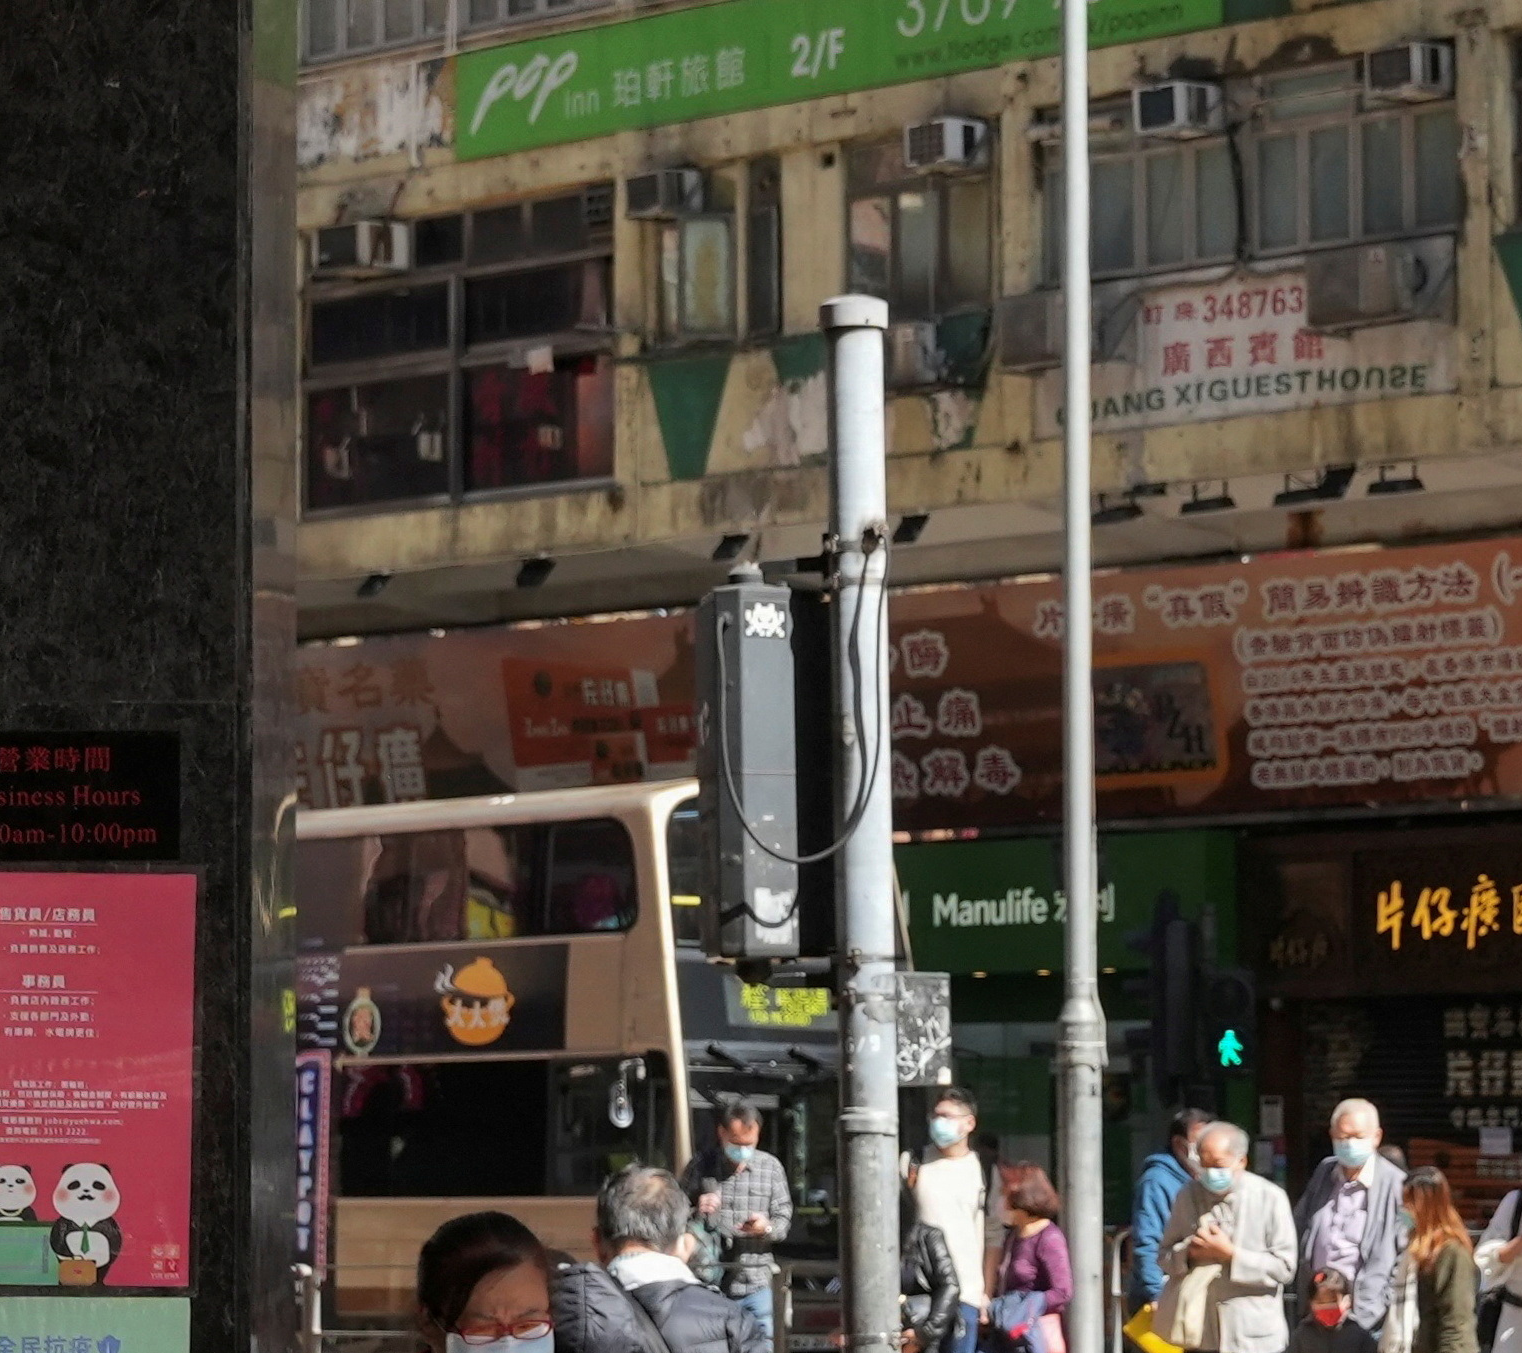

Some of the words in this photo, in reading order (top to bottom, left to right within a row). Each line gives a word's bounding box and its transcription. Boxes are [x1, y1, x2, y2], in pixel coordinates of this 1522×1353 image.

[791, 28, 846, 79] 2/F
[1161, 329, 1325, 377] 廣西賓館
[1035, 595, 1134, 638] 片癀
[73, 785, 142, 807] Hours
[933, 886, 1048, 928] Manulife
